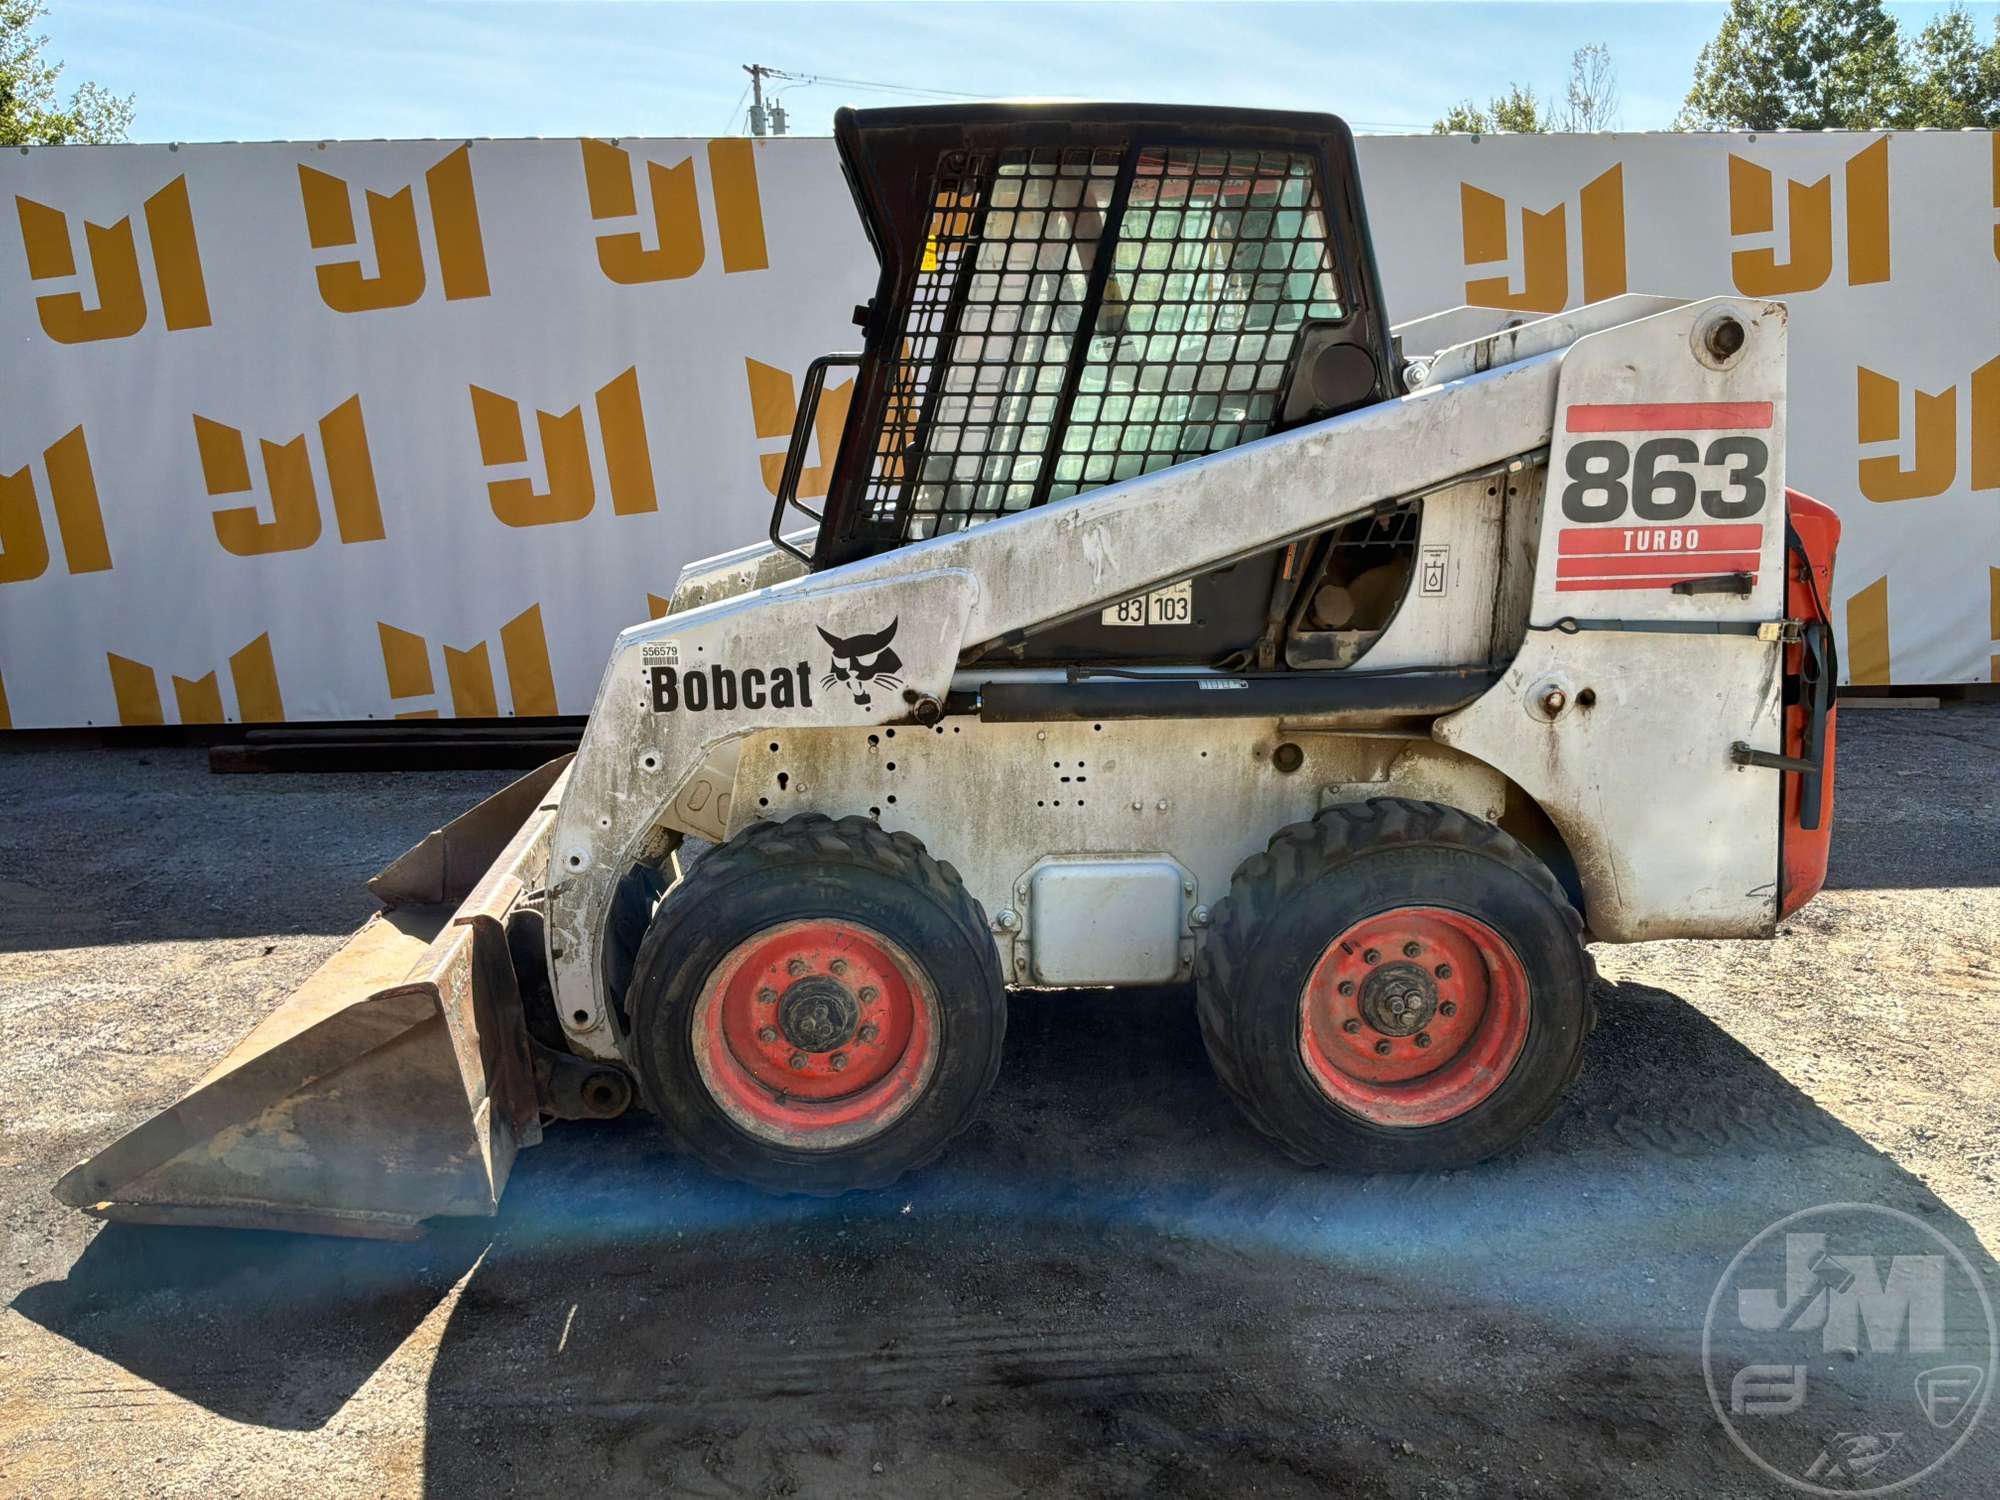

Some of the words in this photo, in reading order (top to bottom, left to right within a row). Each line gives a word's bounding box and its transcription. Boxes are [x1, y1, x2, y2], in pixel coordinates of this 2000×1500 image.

[1561, 436, 1769, 523] 863
[1623, 529, 1699, 551] TURBO
[1117, 599, 1142, 622] 83
[1154, 597, 1188, 621] 103
[642, 646, 678, 657] 556579
[650, 660, 813, 713] Bobcat
